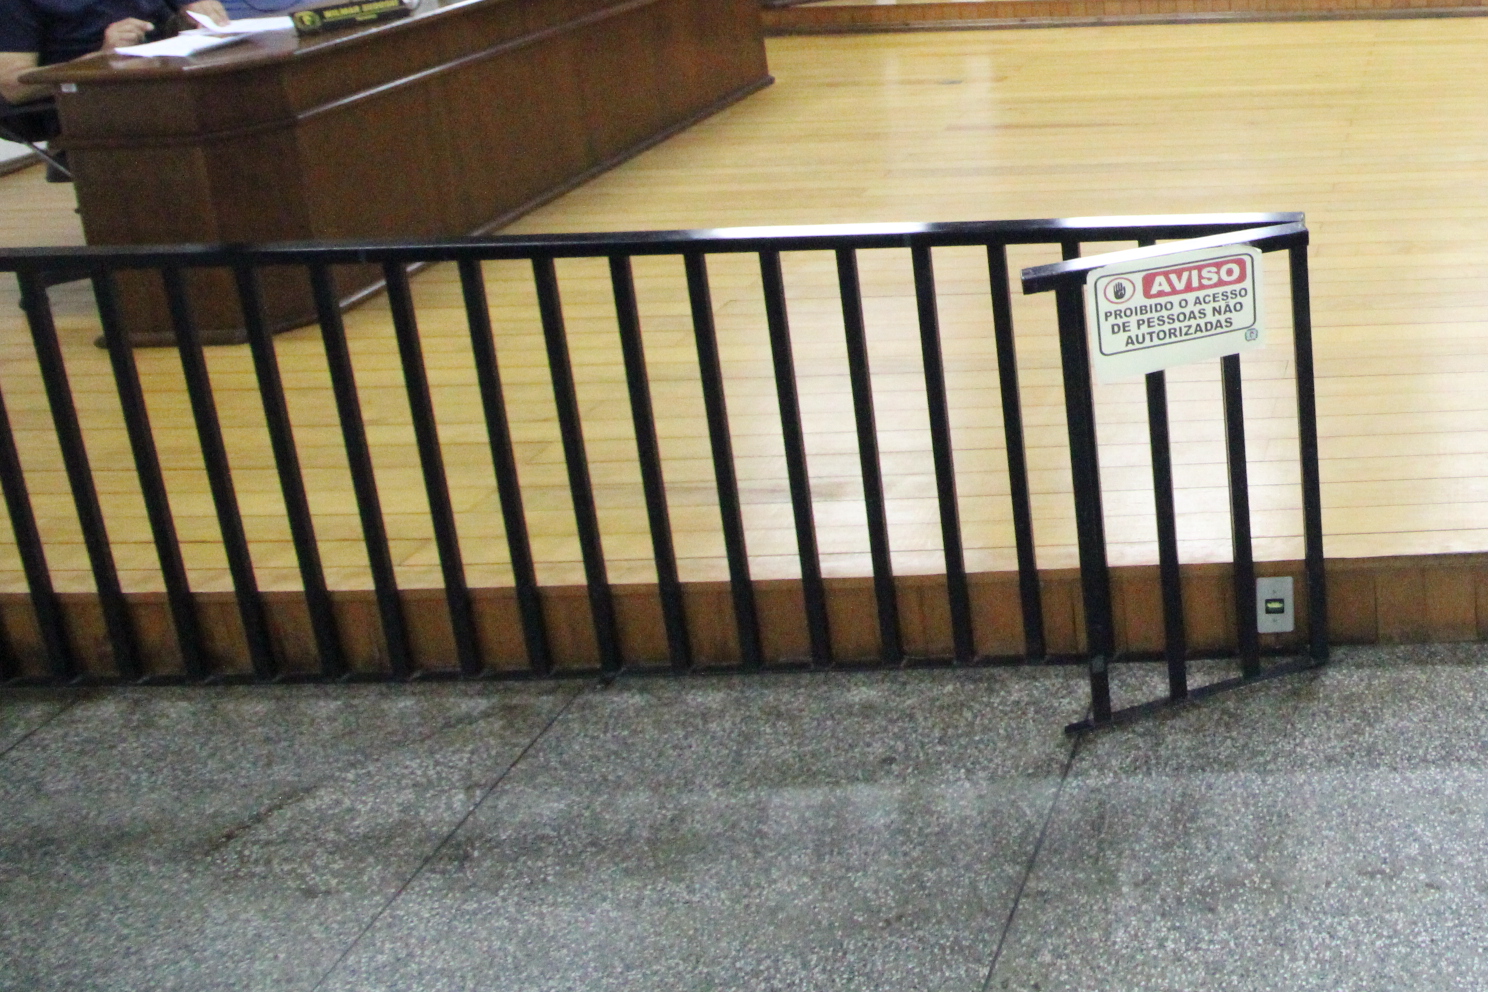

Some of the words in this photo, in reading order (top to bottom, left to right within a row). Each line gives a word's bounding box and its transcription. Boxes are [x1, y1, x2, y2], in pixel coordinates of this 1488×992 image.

[1149, 262, 1241, 295] AVISO
[1104, 300, 1174, 322] PROIBIDO
[1178, 297, 1189, 308] O
[1192, 287, 1249, 307] ACESSO
[1111, 320, 1132, 335] DE
[1136, 308, 1207, 330] PESSOAS
[1212, 301, 1244, 317] NÃO
[1124, 317, 1234, 347] AUTORIZADAS
